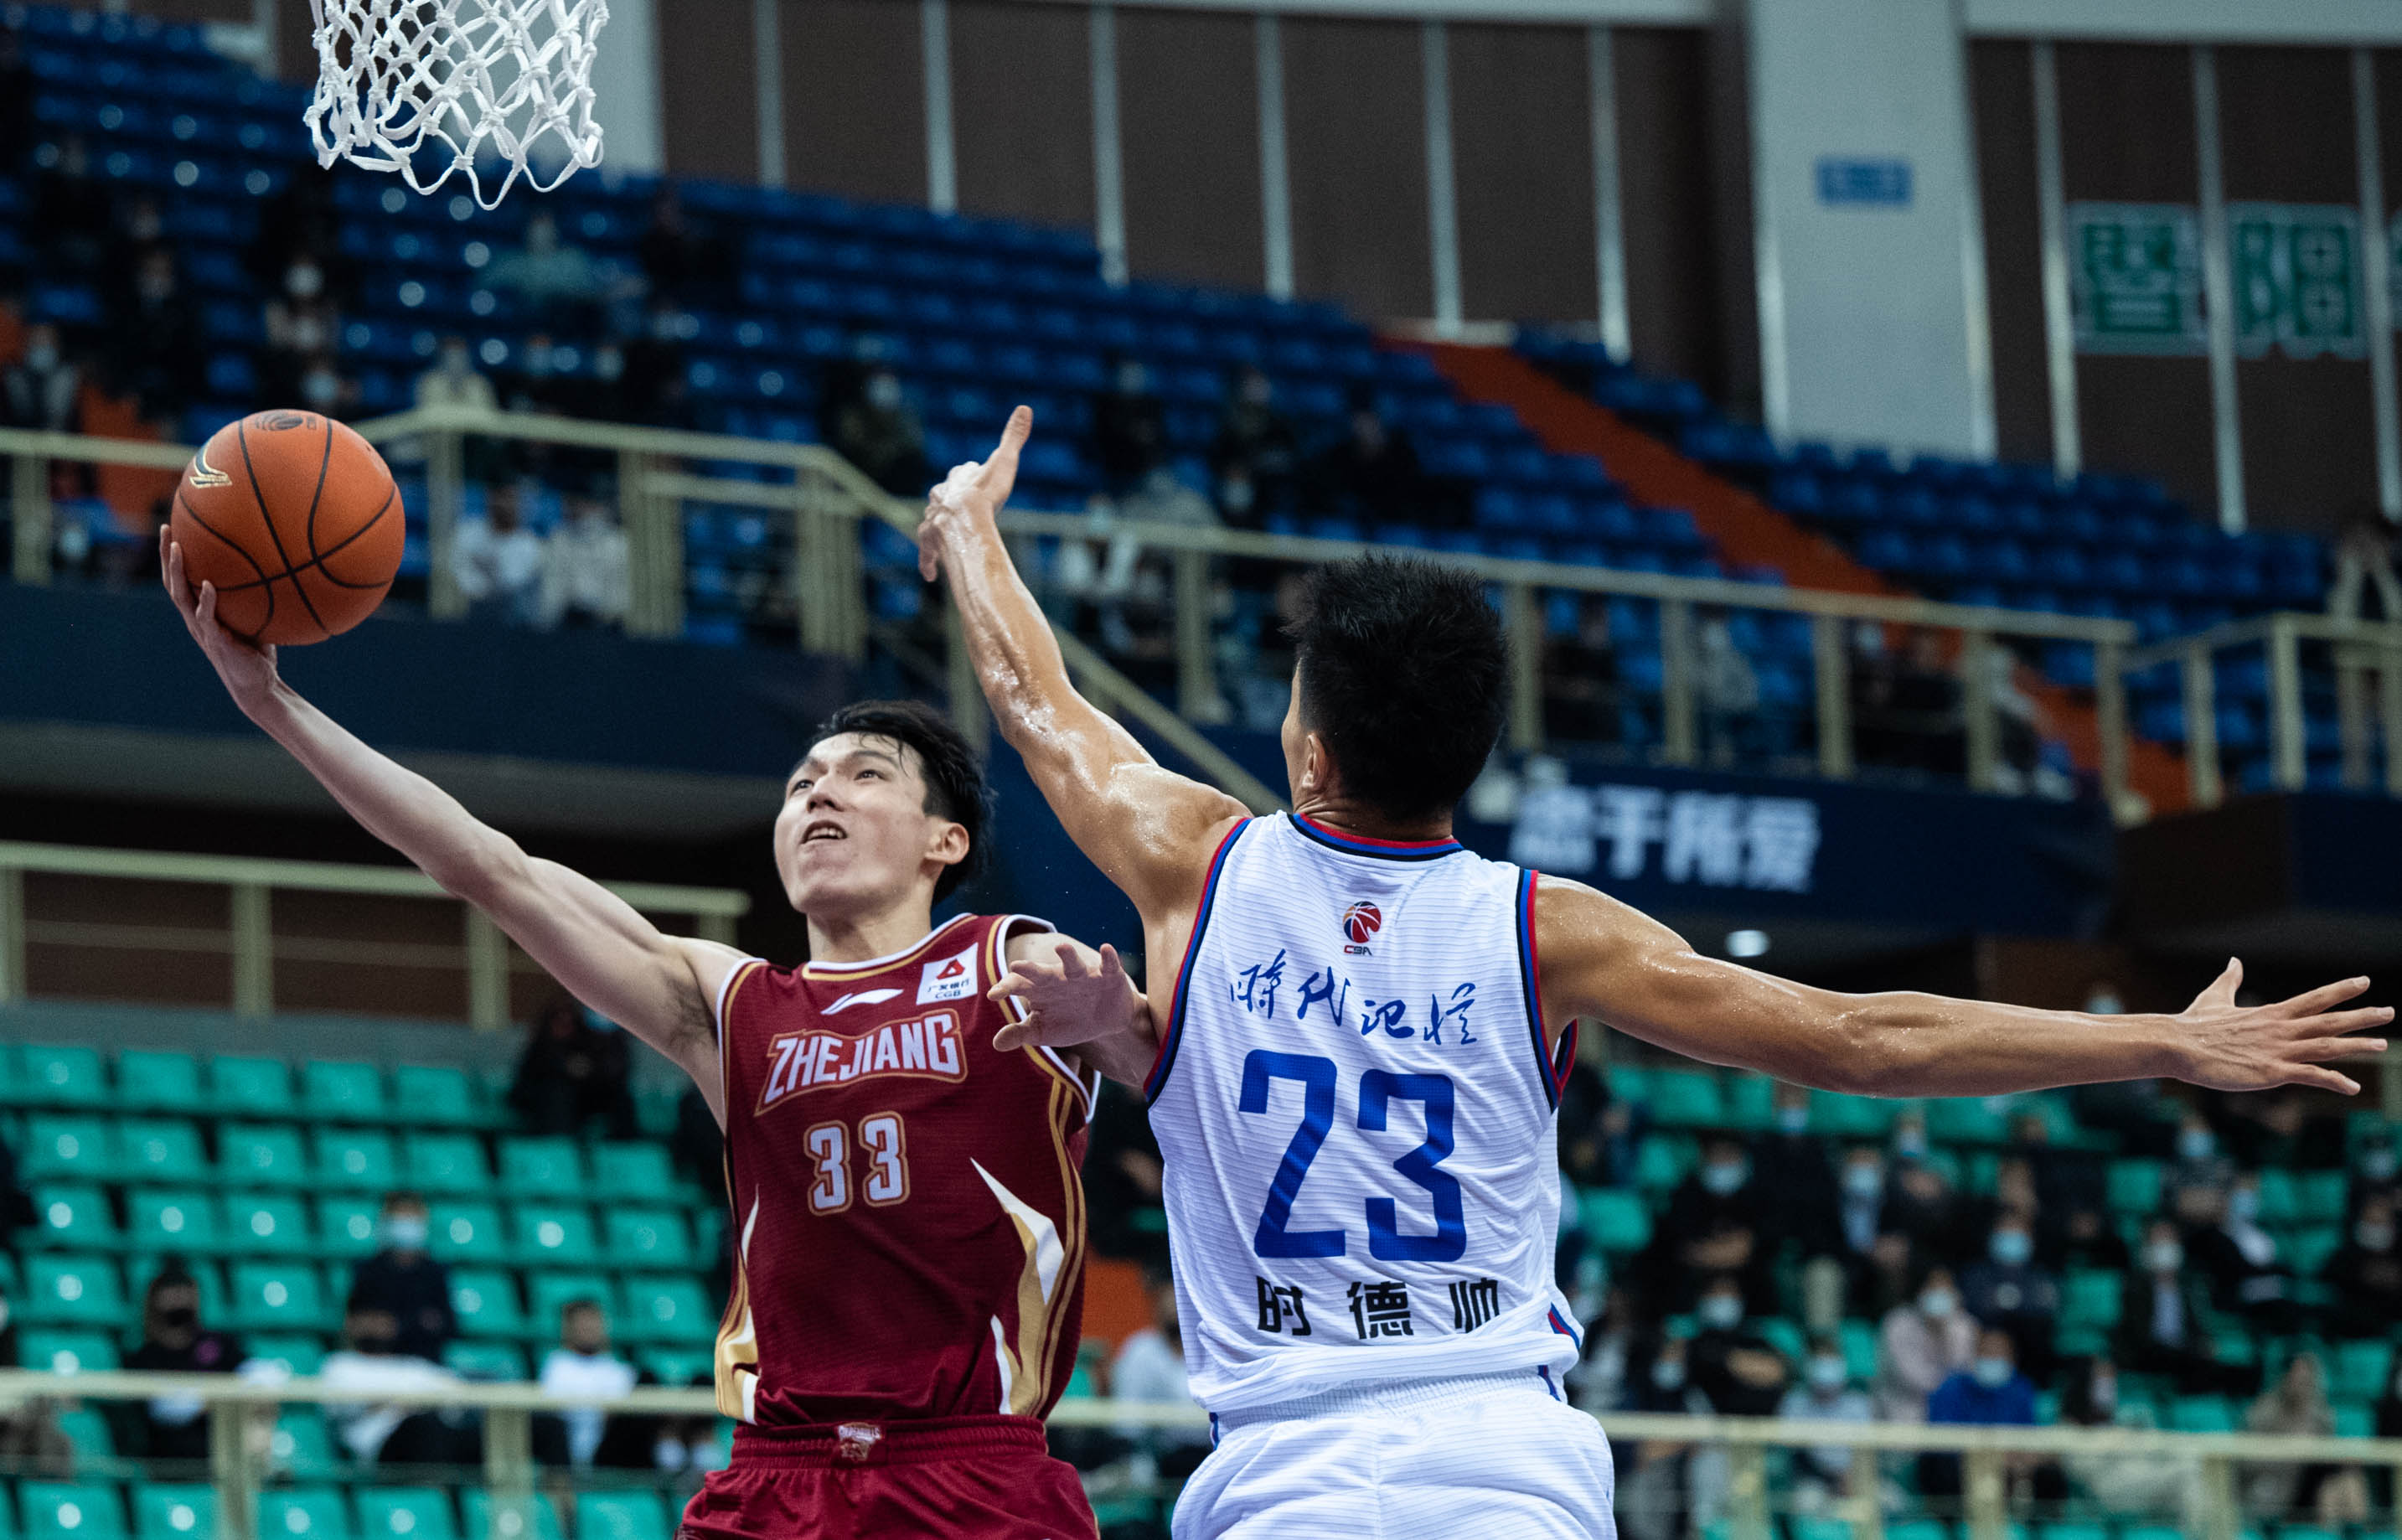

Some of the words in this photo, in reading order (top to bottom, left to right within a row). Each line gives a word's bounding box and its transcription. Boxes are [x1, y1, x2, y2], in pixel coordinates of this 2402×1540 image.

[1343, 944, 1373, 956] CBA
[934, 990, 961, 1000] CGB
[759, 1010, 964, 1111] ZHEJIANG
[805, 1112, 909, 1215] 33
[1238, 1049, 1467, 1262] 23
[1256, 1275, 1501, 1340] 时德帅
